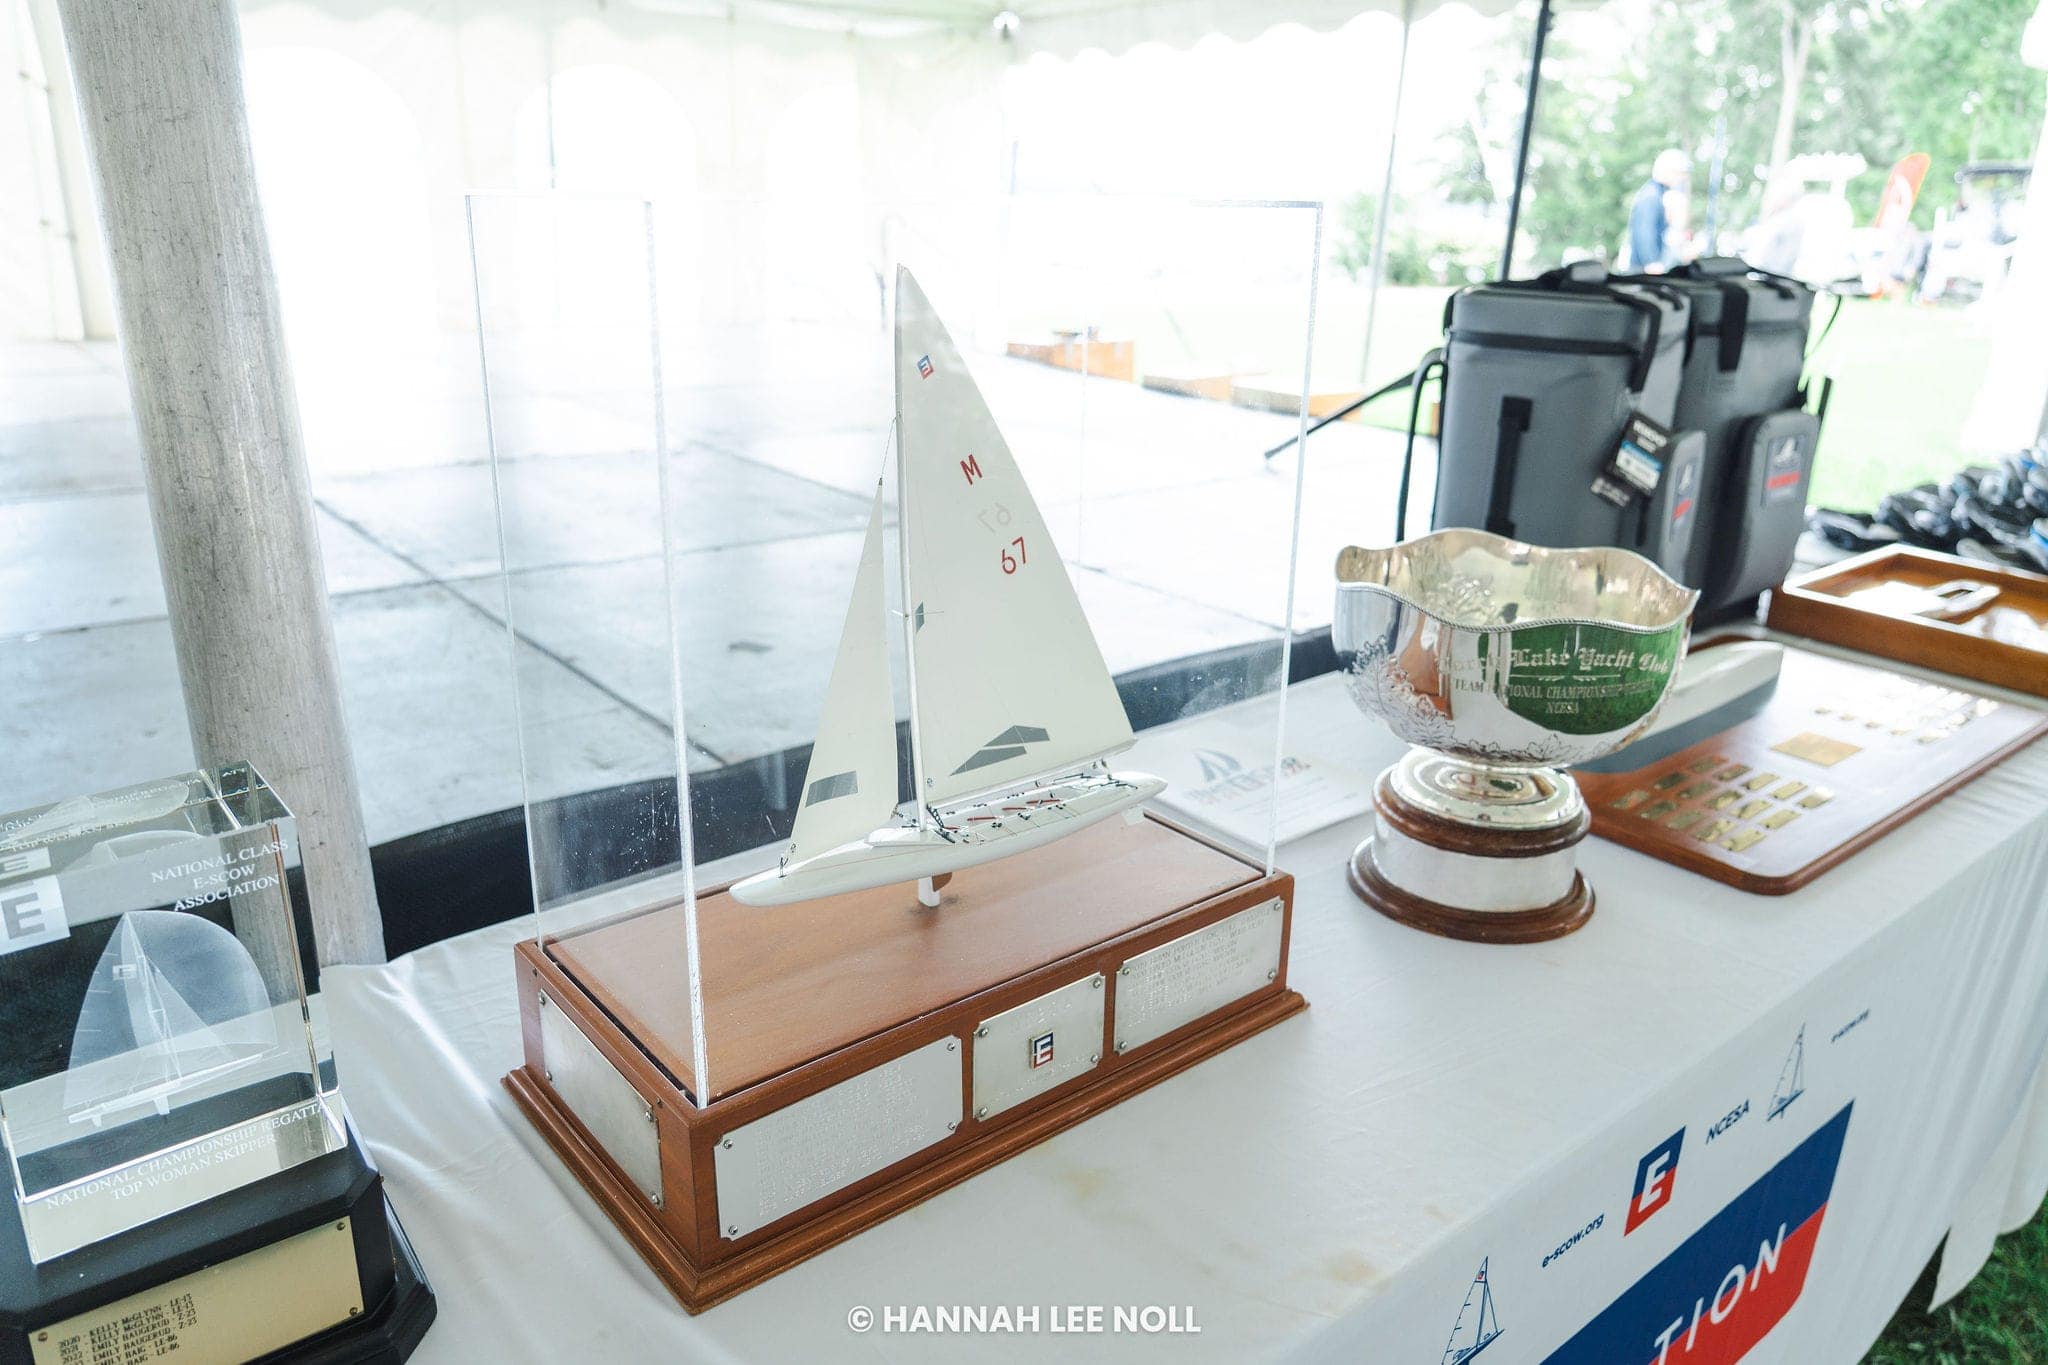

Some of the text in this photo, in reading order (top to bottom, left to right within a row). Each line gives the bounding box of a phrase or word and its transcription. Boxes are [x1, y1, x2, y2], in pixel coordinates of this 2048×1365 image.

[960, 454, 983, 485] M
[1001, 536, 1027, 574] 67
[1511, 646, 1570, 667] Lake
[1579, 647, 1635, 671] Yacht
[1639, 652, 1669, 673] Club
[151, 839, 289, 883] NATIONAL CLASS
[193, 864, 256, 890] E-SCOW
[174, 874, 280, 912] ASSOCIATION
[1705, 1099, 1749, 1144] NCESA
[47, 1103, 324, 1210] NATIONAL CHAMPIONSHIP REGATTA
[110, 1134, 277, 1200] TOP WOMAN SKIPPER
[1542, 1212, 1604, 1268] e-scow.org
[1654, 1222, 1787, 1365] TION
